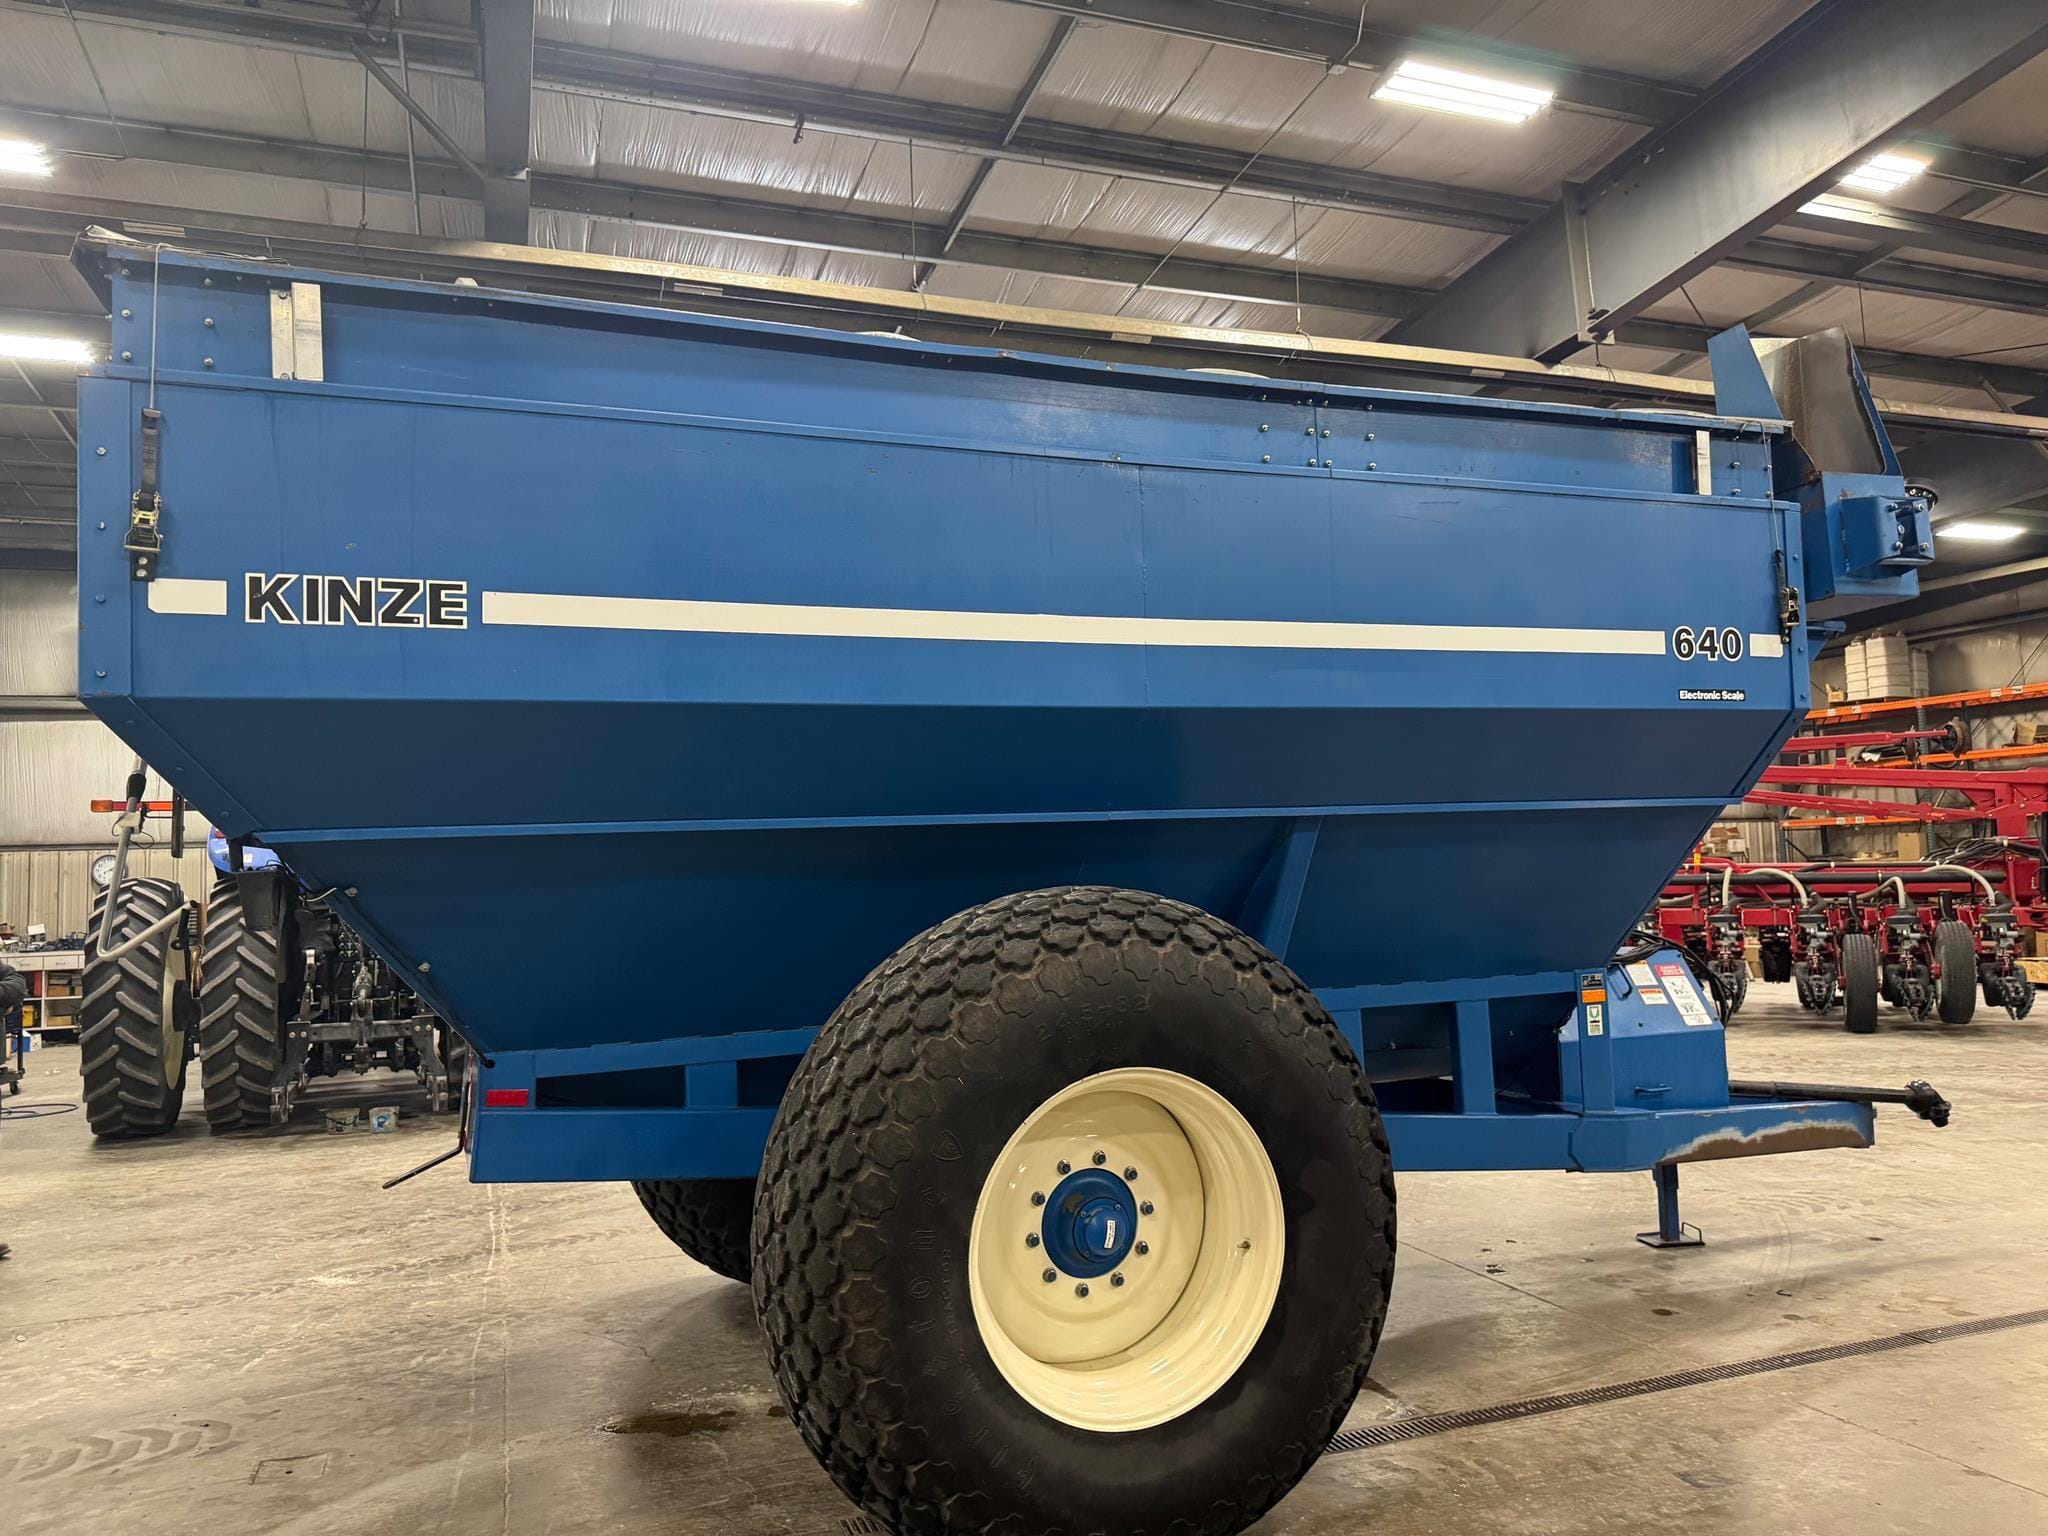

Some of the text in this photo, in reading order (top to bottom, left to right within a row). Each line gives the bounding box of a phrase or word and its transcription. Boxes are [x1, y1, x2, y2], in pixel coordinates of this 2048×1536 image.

[244, 572, 468, 630] KINZE
[1672, 625, 1744, 662] 640
[1679, 690, 1745, 702] Electronic Scale
